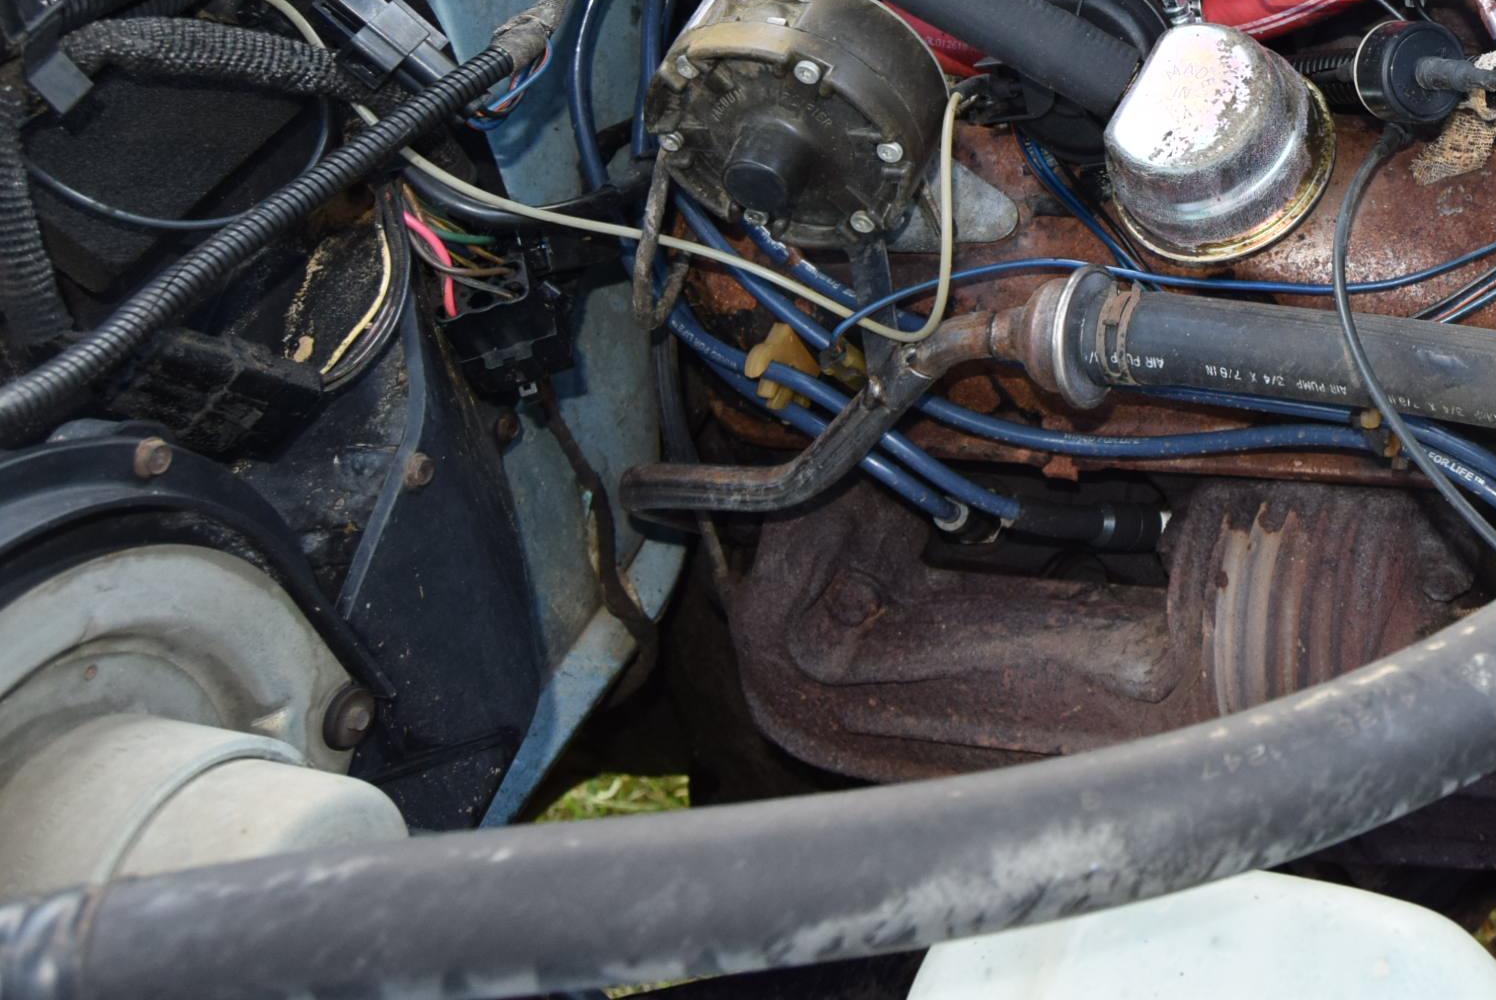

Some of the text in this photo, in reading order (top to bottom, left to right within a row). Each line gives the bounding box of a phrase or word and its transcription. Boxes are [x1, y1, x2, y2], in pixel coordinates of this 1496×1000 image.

[1110, 352, 1141, 368] PUP
[1144, 358, 1165, 369] AIR
[1262, 374, 1285, 387] 3/4
[1296, 380, 1326, 394] PUMP
[1330, 385, 1347, 396] AIR
[1428, 451, 1450, 468] FOR
